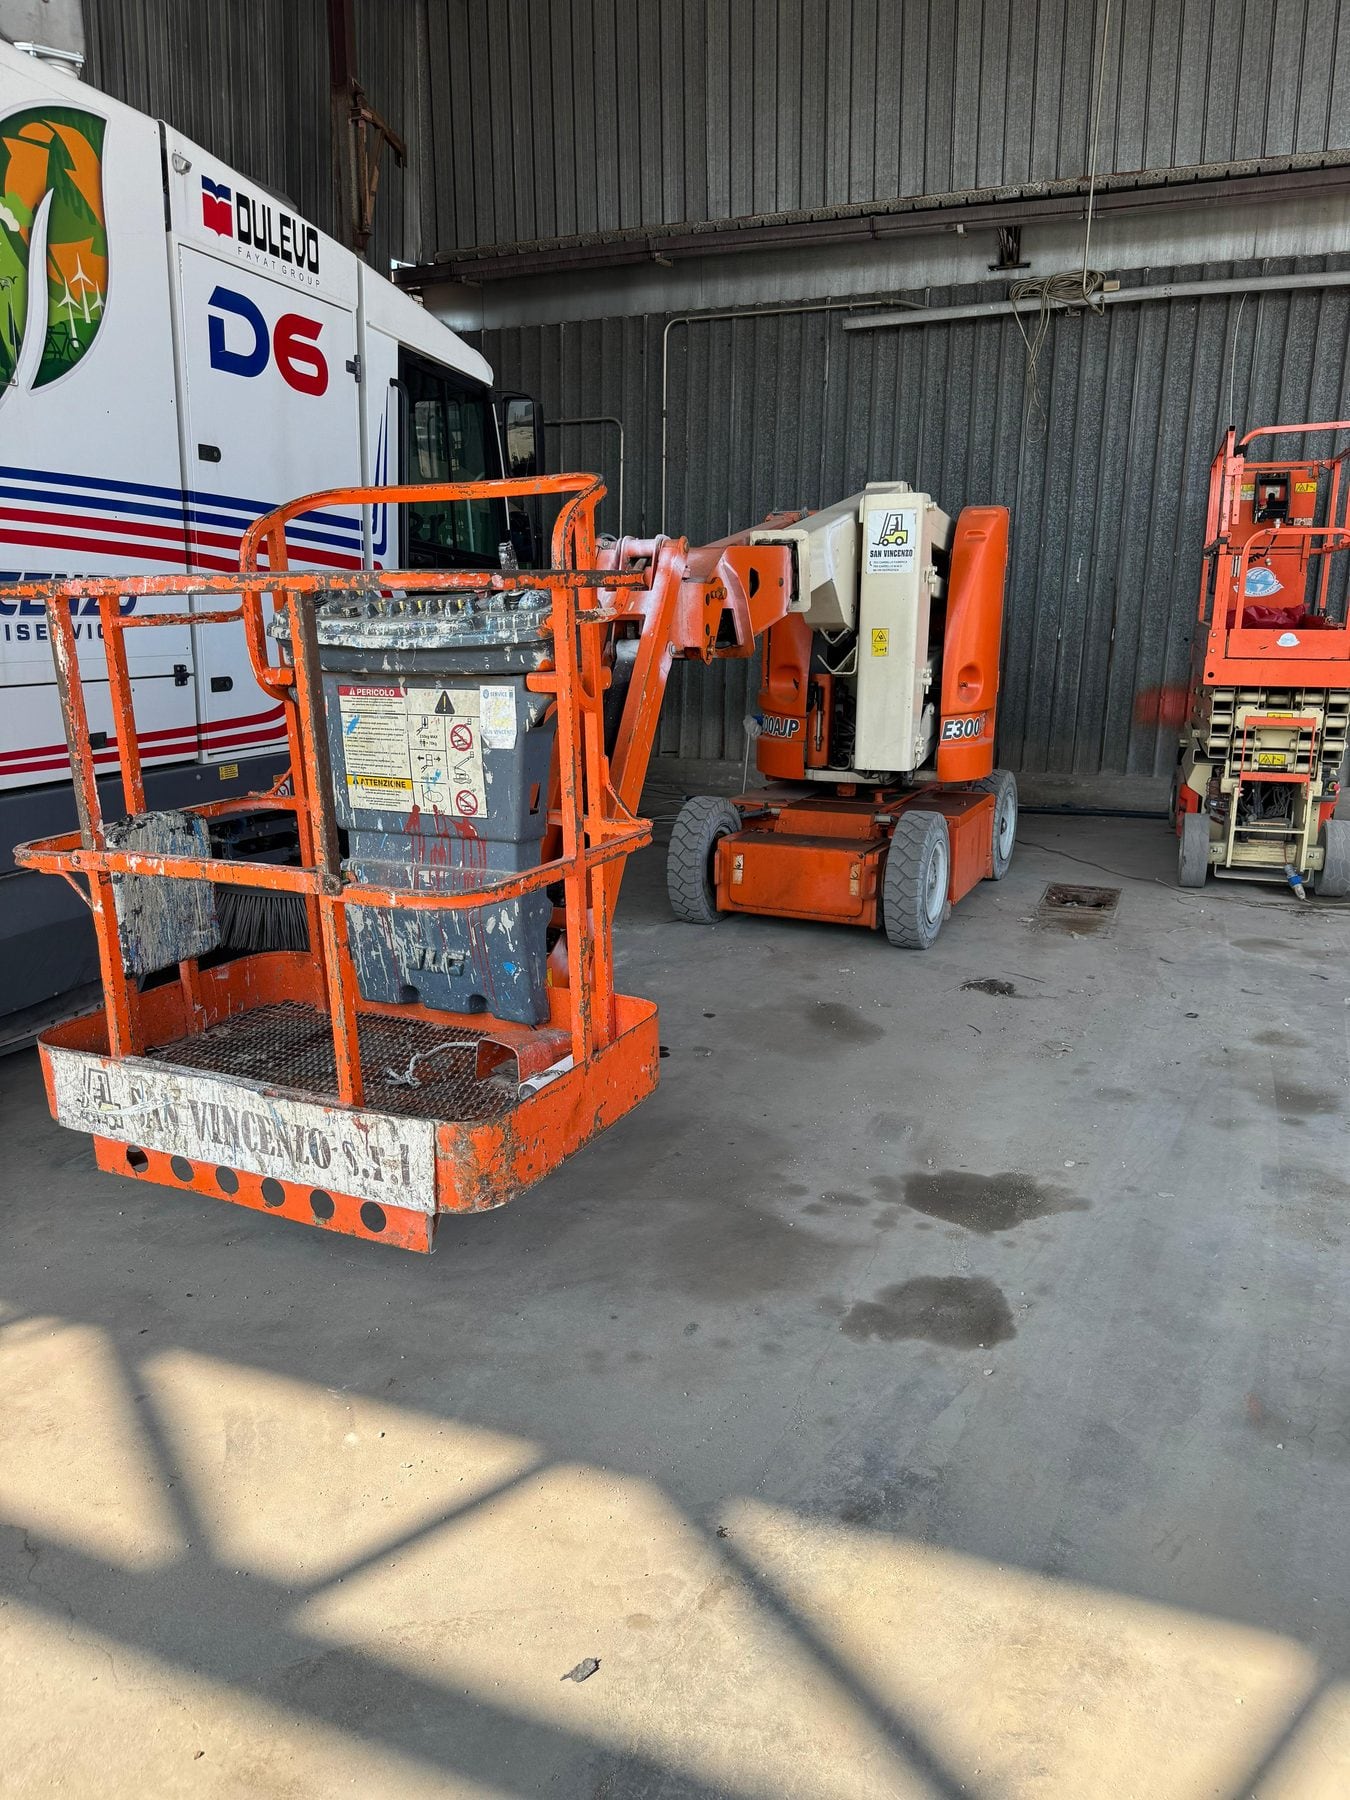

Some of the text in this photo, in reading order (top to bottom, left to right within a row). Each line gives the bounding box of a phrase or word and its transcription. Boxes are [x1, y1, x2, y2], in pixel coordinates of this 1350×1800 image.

[236, 191, 320, 275] DULEVO
[238, 246, 321, 287] FAYAT GROUP
[207, 285, 329, 397] D6
[870, 549, 913, 558] SAN VINCENZO
[356, 687, 395, 697] PERICOLO
[186, 1099, 332, 1170] VINCENZO
